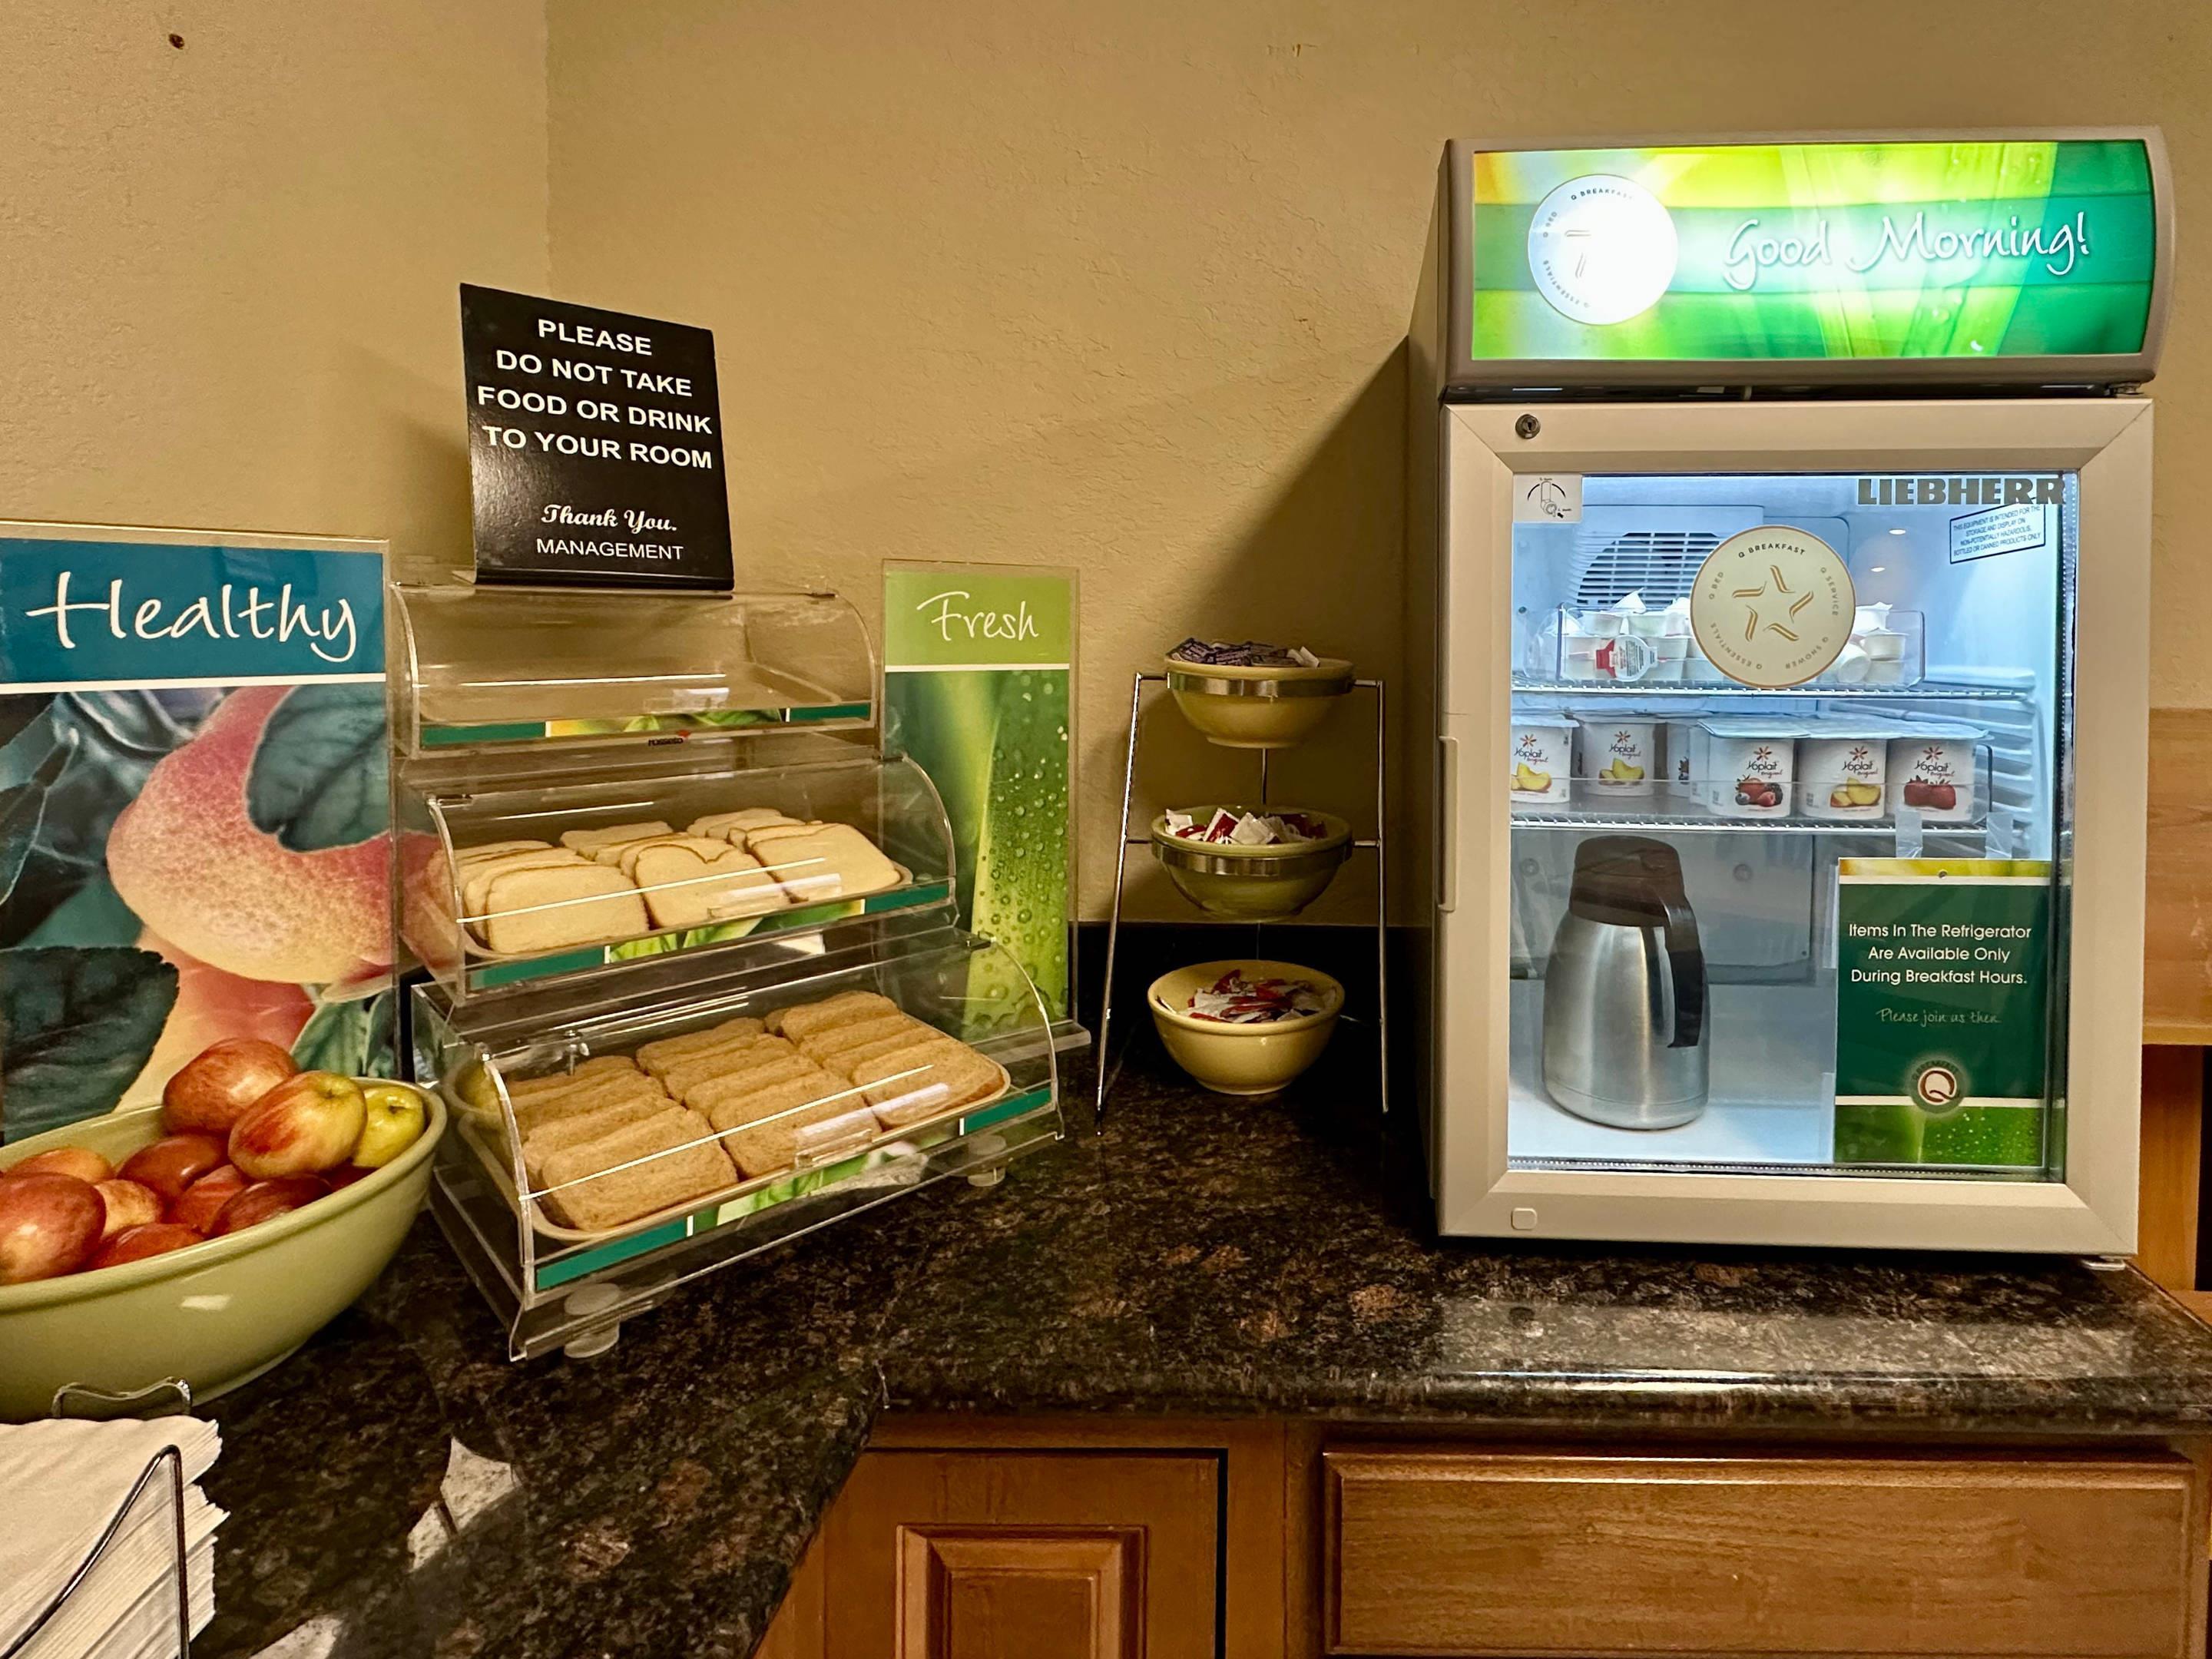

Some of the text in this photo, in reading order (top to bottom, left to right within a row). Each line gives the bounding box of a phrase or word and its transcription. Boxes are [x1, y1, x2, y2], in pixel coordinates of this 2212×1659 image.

[1723, 211, 2090, 290] Good Morning!
[538, 319, 652, 356] PLEASE
[496, 349, 692, 397] DO NOT TAKE
[478, 386, 713, 435] FOOD OR DRINK
[482, 425, 712, 469] TO YOUR ROOM
[1858, 478, 2066, 505] LIEBHERR
[541, 504, 677, 534] Thank You.
[536, 538, 684, 560] MANAGEMENT
[1749, 543, 1806, 555] BREAKFAST
[1713, 571, 1724, 590] BED
[1826, 575, 1839, 616] SERVICE
[25, 571, 357, 662] Healthy
[916, 591, 1039, 641] Fresh
[1710, 622, 1752, 667] ESSENTIALS
[1785, 645, 1822, 670] SHOWER
[1747, 760, 1777, 773] Yoplait
[1841, 760, 1873, 773] Yoplait
[1914, 760, 1949, 773] Yoplait
[1849, 924, 2032, 940] Items In The Refrigerator
[1869, 947, 2011, 963] Are Available Only
[1851, 969, 2028, 985] During Breakfast Hours.
[1876, 1008, 1919, 1022] Please
[1921, 1009, 1946, 1027] join
[1951, 1014, 1965, 1023] us
